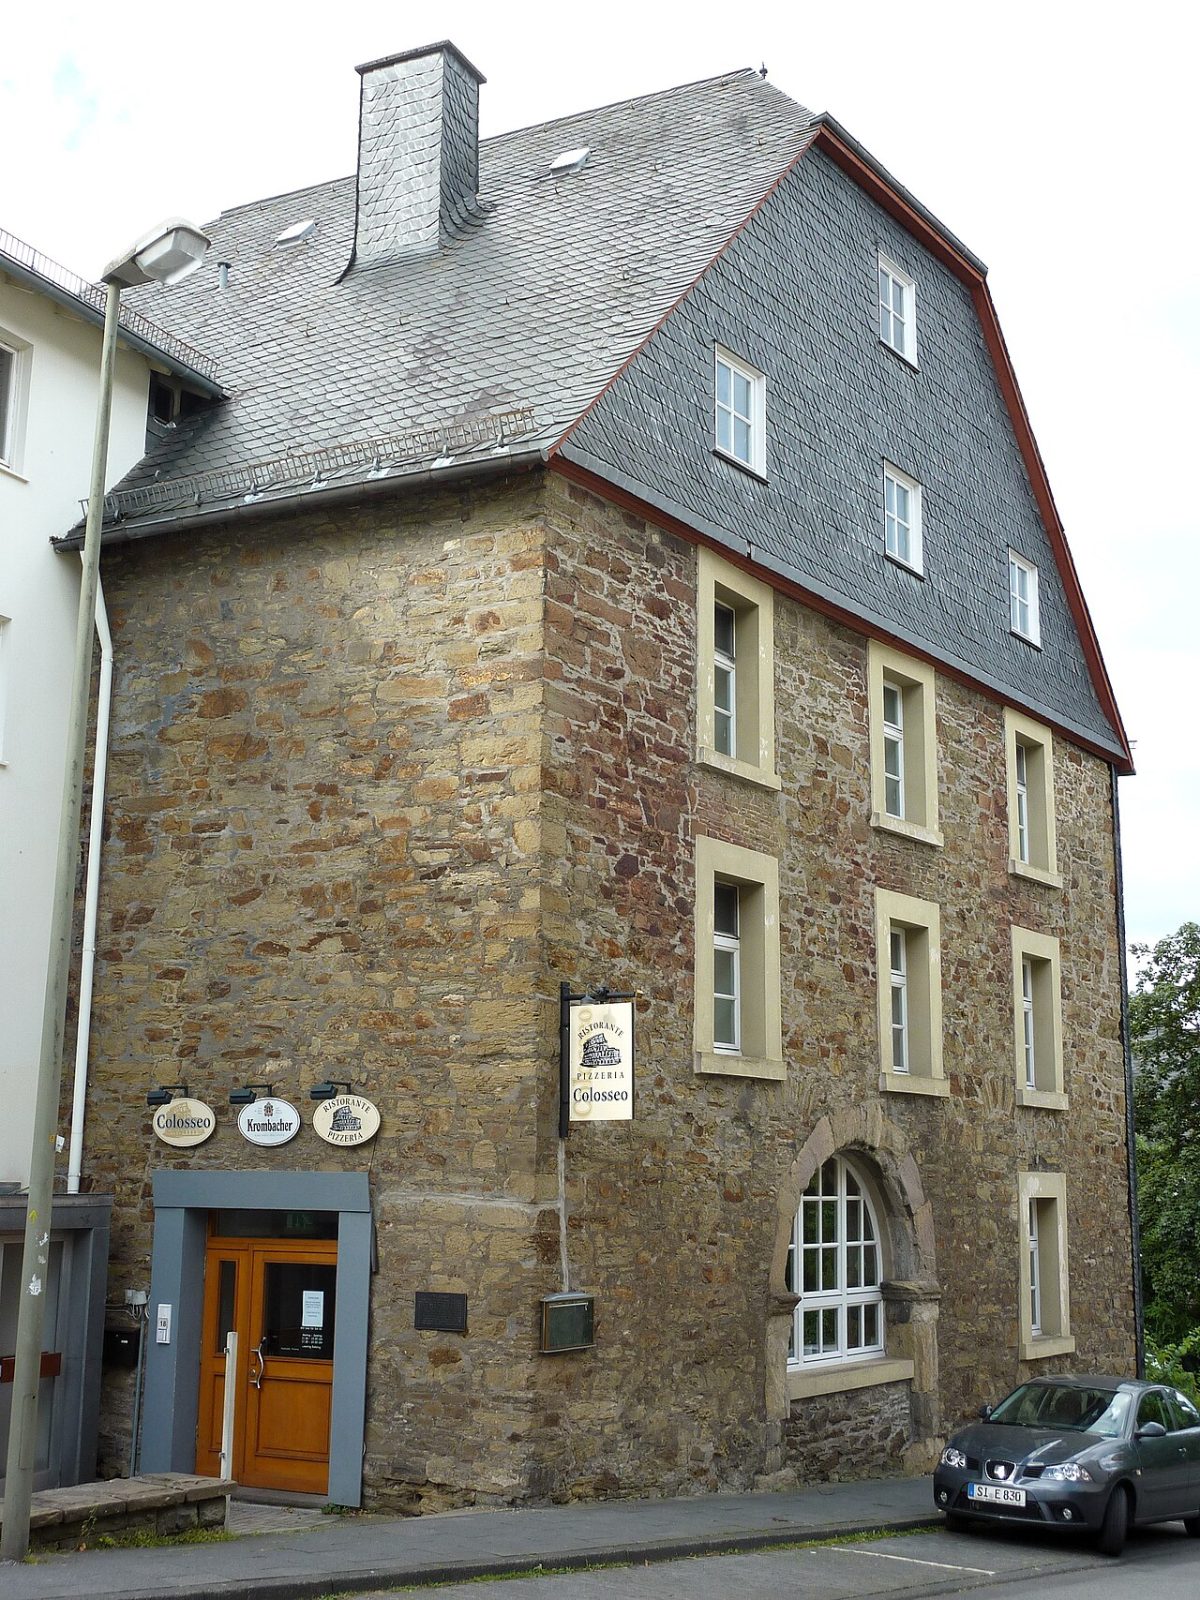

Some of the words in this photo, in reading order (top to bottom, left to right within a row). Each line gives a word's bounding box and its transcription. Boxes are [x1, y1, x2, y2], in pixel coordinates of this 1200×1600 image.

[577, 1021, 625, 1040] RISTORANTE
[576, 1071, 625, 1080] PIZZERIA
[573, 1087, 629, 1102] Colosseo
[322, 1097, 372, 1114] RISTORANTE
[157, 1113, 211, 1129] Colosseo
[247, 1118, 293, 1132] Krombacher
[327, 1130, 363, 1142] PIZZERIA
[977, 1486, 988, 1498] SI
[994, 1489, 1001, 1499] E
[1003, 1490, 1021, 1502] 830
